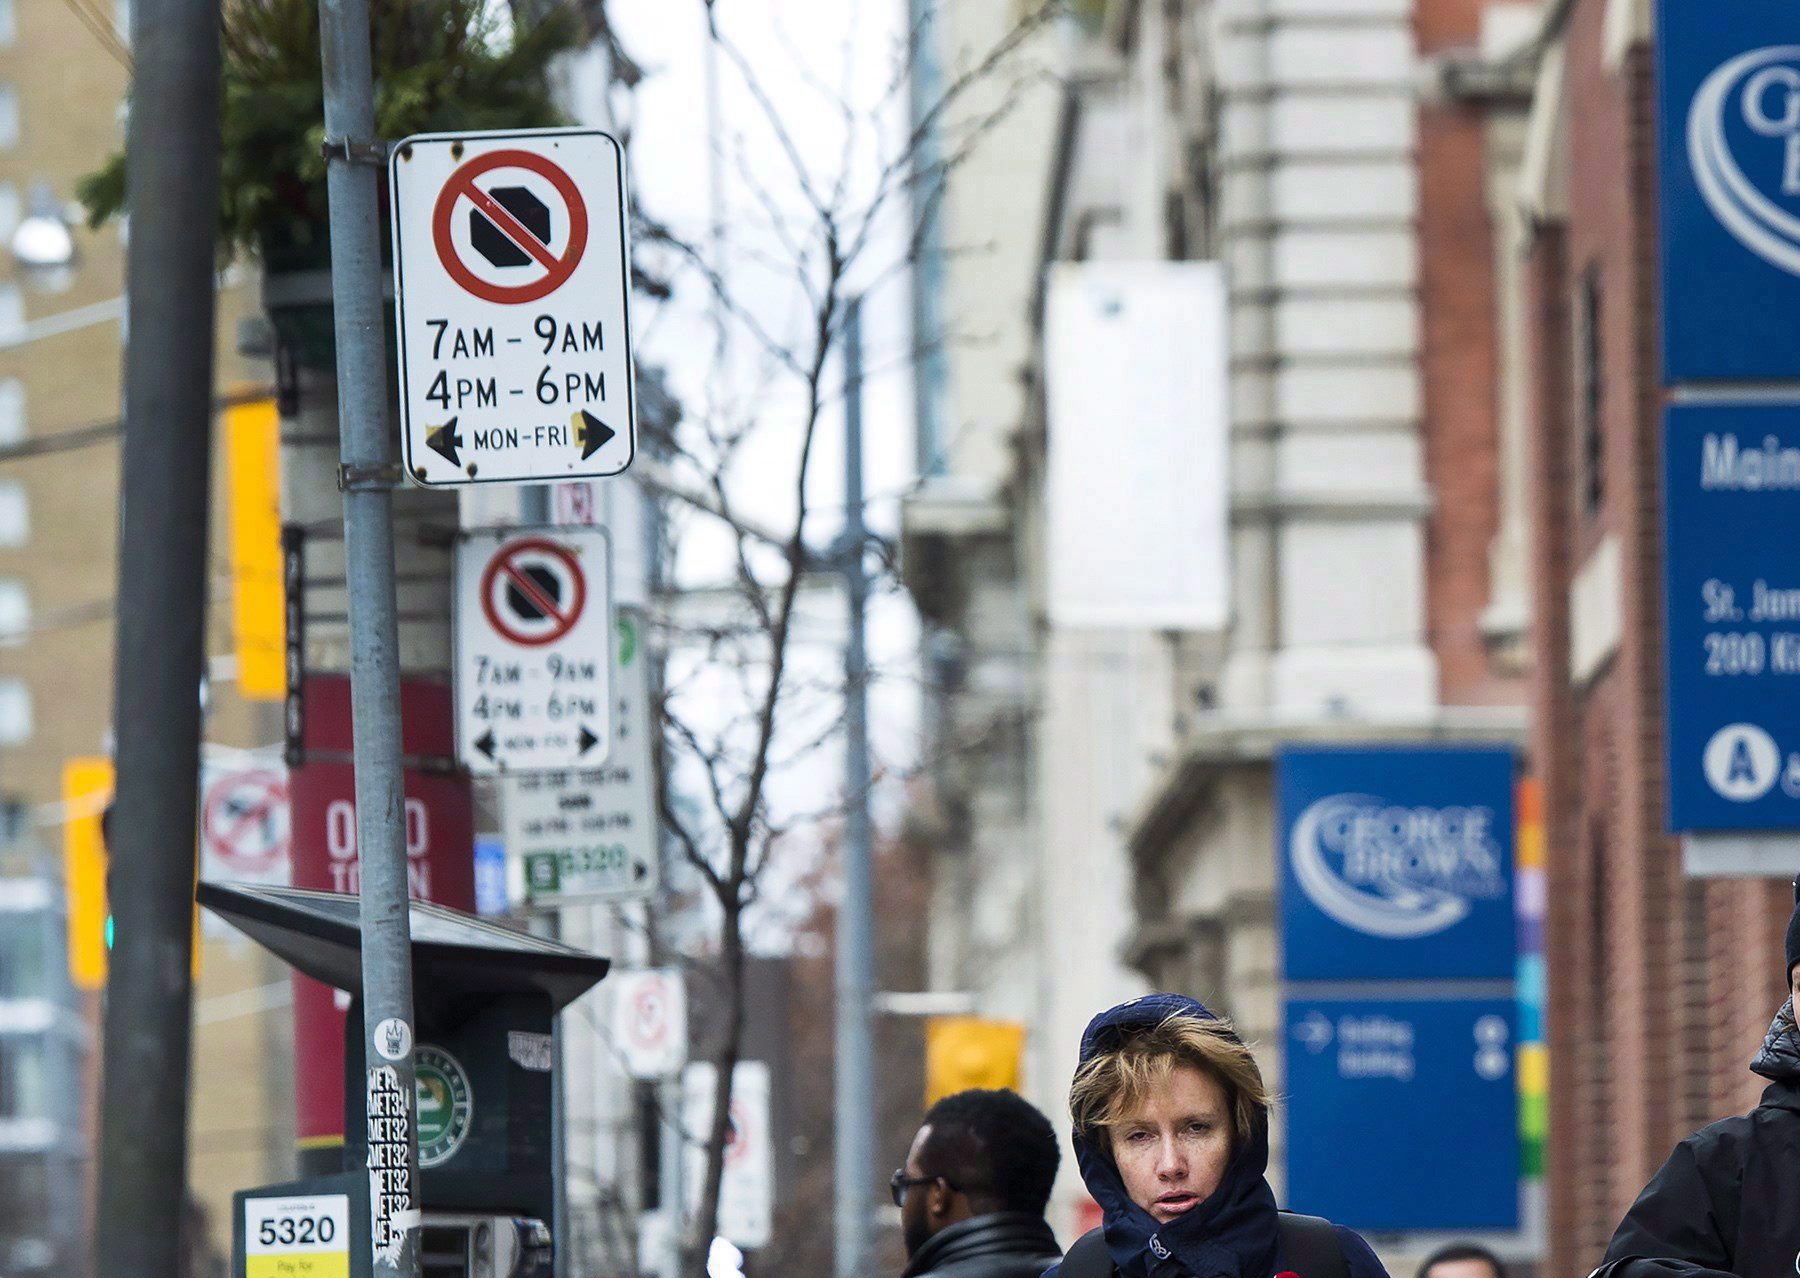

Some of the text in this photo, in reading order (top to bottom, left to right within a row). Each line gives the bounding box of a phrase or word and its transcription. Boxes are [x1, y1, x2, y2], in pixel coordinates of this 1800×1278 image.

[426, 319, 495, 360] 7AM
[534, 314, 604, 355] 9AM
[425, 369, 498, 410] 4PM
[535, 365, 606, 405] 6PM
[473, 425, 568, 451] MON-FRI
[1702, 578, 1744, 623] St.
[1703, 632, 1765, 676] 200
[1724, 737, 1758, 785] A
[327, 799, 429, 858] OD
[260, 1217, 335, 1245] 5320
